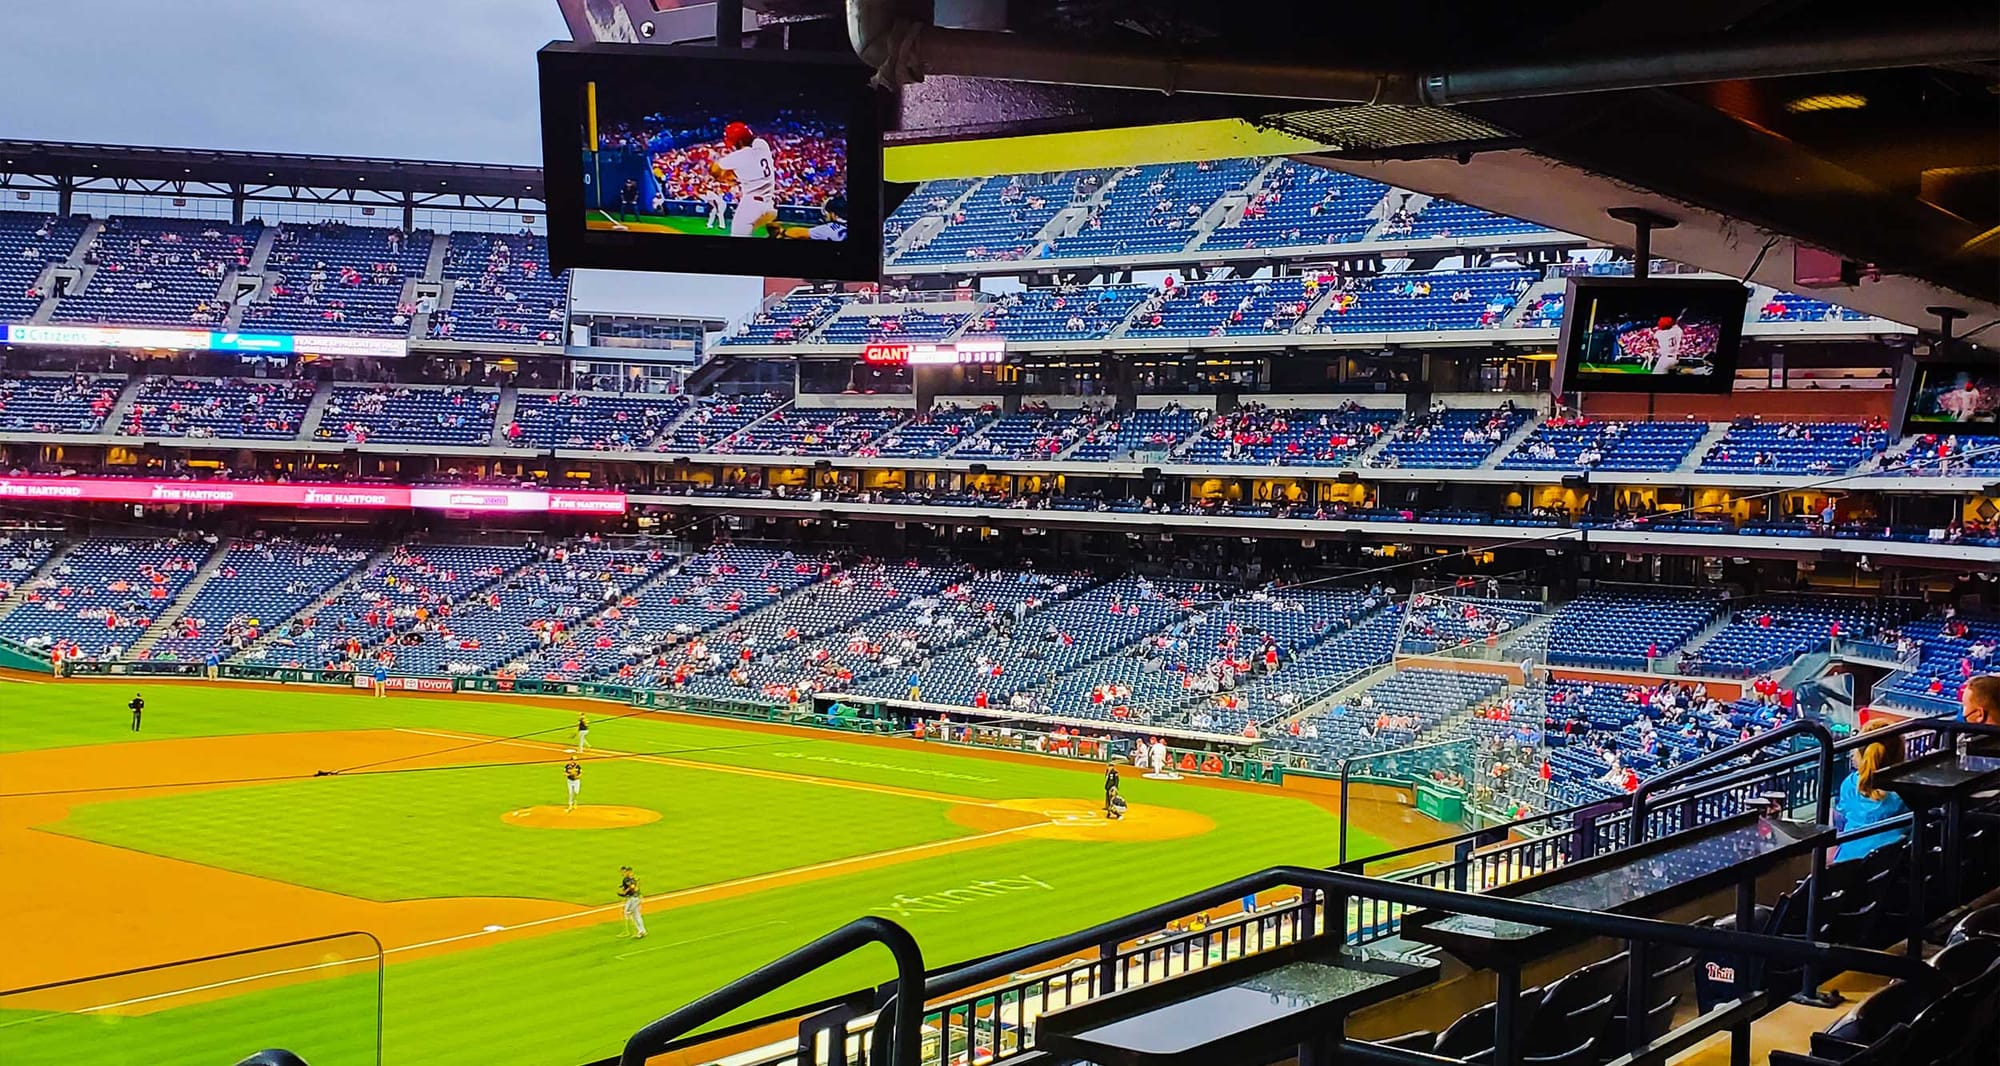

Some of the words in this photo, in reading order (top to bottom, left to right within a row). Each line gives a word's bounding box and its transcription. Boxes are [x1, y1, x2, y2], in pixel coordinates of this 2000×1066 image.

[759, 158, 771, 177] 3
[30, 328, 88, 342] Citizens
[867, 347, 908, 360] GIANT
[7, 485, 26, 495] THE
[28, 486, 80, 497] HARTFORD
[162, 490, 180, 499] THE
[183, 490, 234, 500] HARTFORD
[314, 493, 333, 502] THE
[335, 494, 386, 503] HARTFORD
[369, 679, 403, 688] TOTA
[419, 680, 453, 690] TOYOTA
[869, 875, 1054, 917] xfinity
